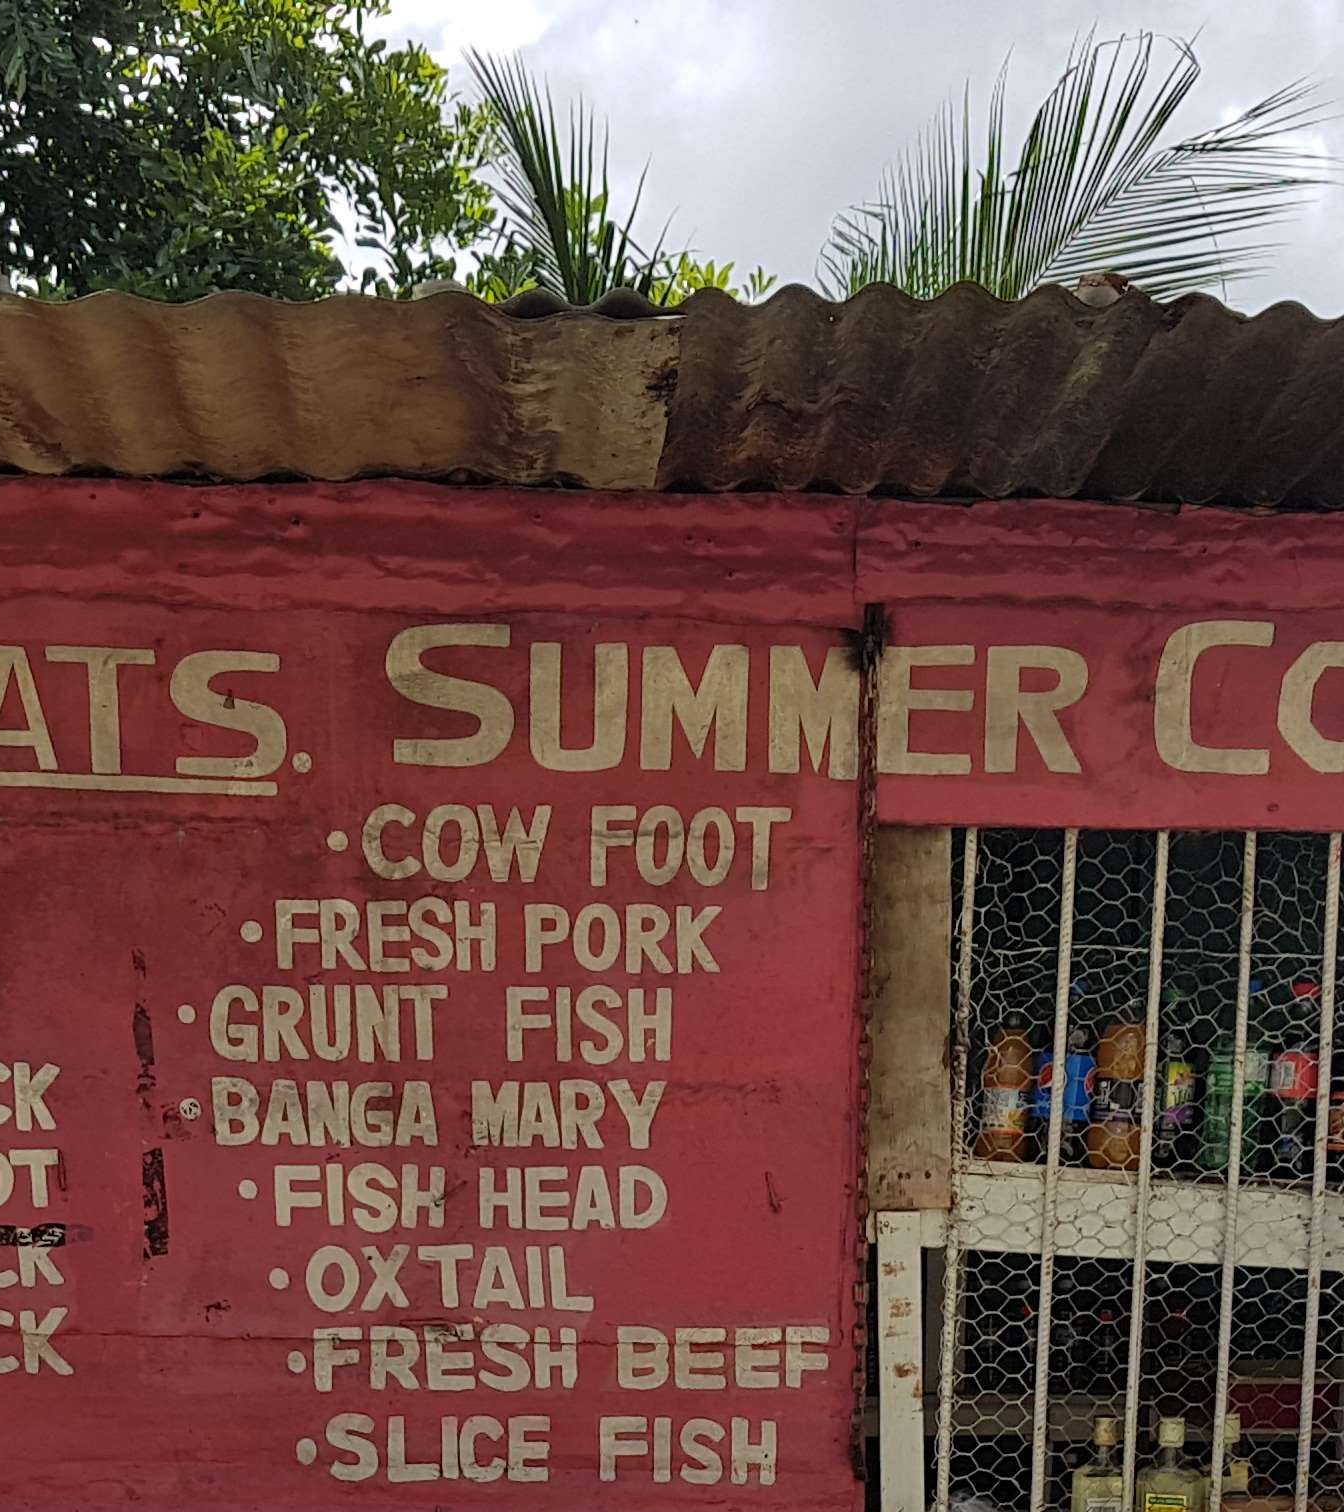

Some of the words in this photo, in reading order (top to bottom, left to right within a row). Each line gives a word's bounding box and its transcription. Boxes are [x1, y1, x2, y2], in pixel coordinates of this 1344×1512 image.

[386, 624, 1088, 779] SUMMER
[363, 805, 551, 881] COW
[591, 806, 790, 889] FOOT
[276, 897, 496, 971] FRESH
[525, 904, 721, 973] PORK
[211, 985, 448, 1062] GRUNT
[507, 985, 672, 1064] FISH
[212, 1077, 437, 1147] BANGA
[472, 1080, 664, 1149] MARY
[275, 1163, 444, 1232] FISH
[480, 1166, 667, 1230] HEAD
[313, 1325, 577, 1391] FRESH
[618, 1327, 829, 1389] BEEF
[326, 1414, 549, 1482] SLICE
[600, 1417, 776, 1485] FISH
